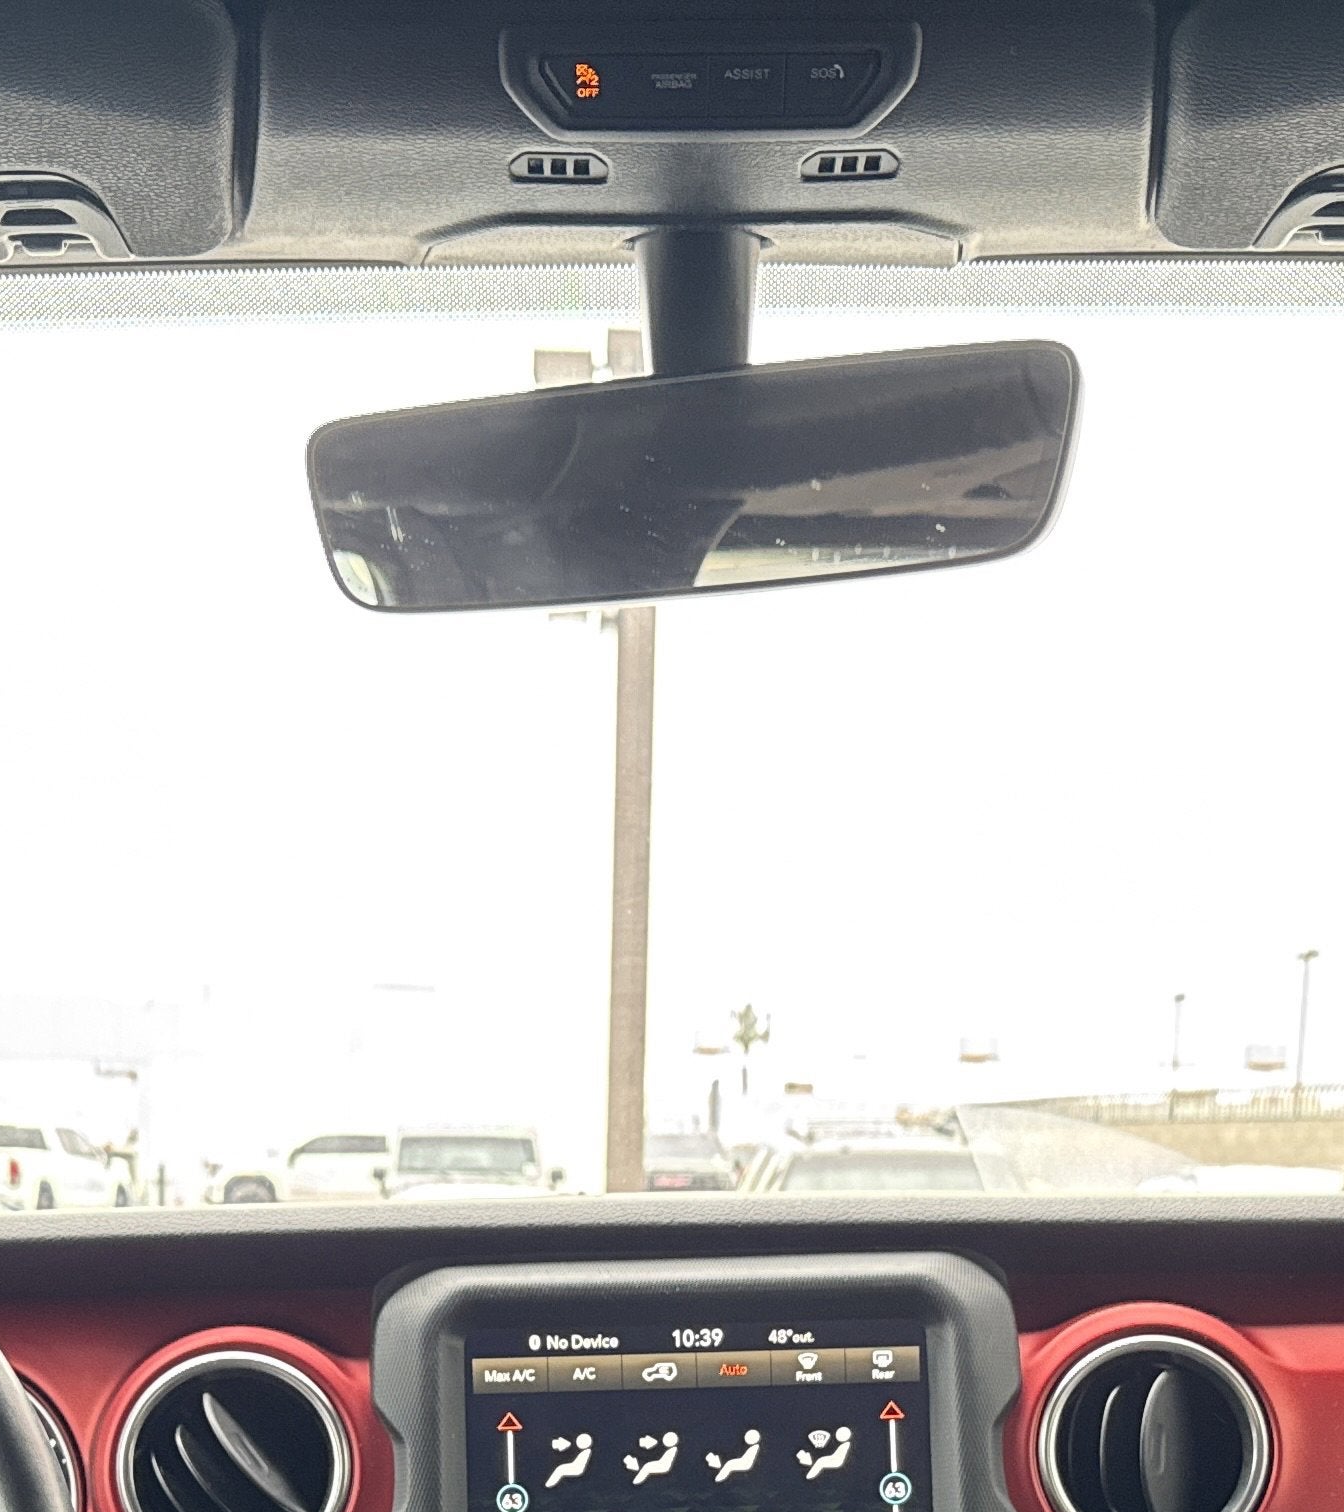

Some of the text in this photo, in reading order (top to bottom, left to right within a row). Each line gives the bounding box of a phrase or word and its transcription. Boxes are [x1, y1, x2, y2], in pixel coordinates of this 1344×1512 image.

[724, 68, 771, 80] ASSIST
[810, 67, 837, 79] SOS
[655, 80, 693, 89] AIRBAG
[576, 87, 600, 98] OFF
[546, 1333, 619, 1350] No Device
[672, 1327, 723, 1349] 10:39
[484, 1368, 536, 1383] Max A/C
[572, 1367, 596, 1380] A/C
[719, 1363, 748, 1376] Auto
[871, 1368, 896, 1380] Rear
[795, 1371, 823, 1382] Front
[884, 1481, 907, 1498] 63
[502, 1492, 523, 1509] 63
